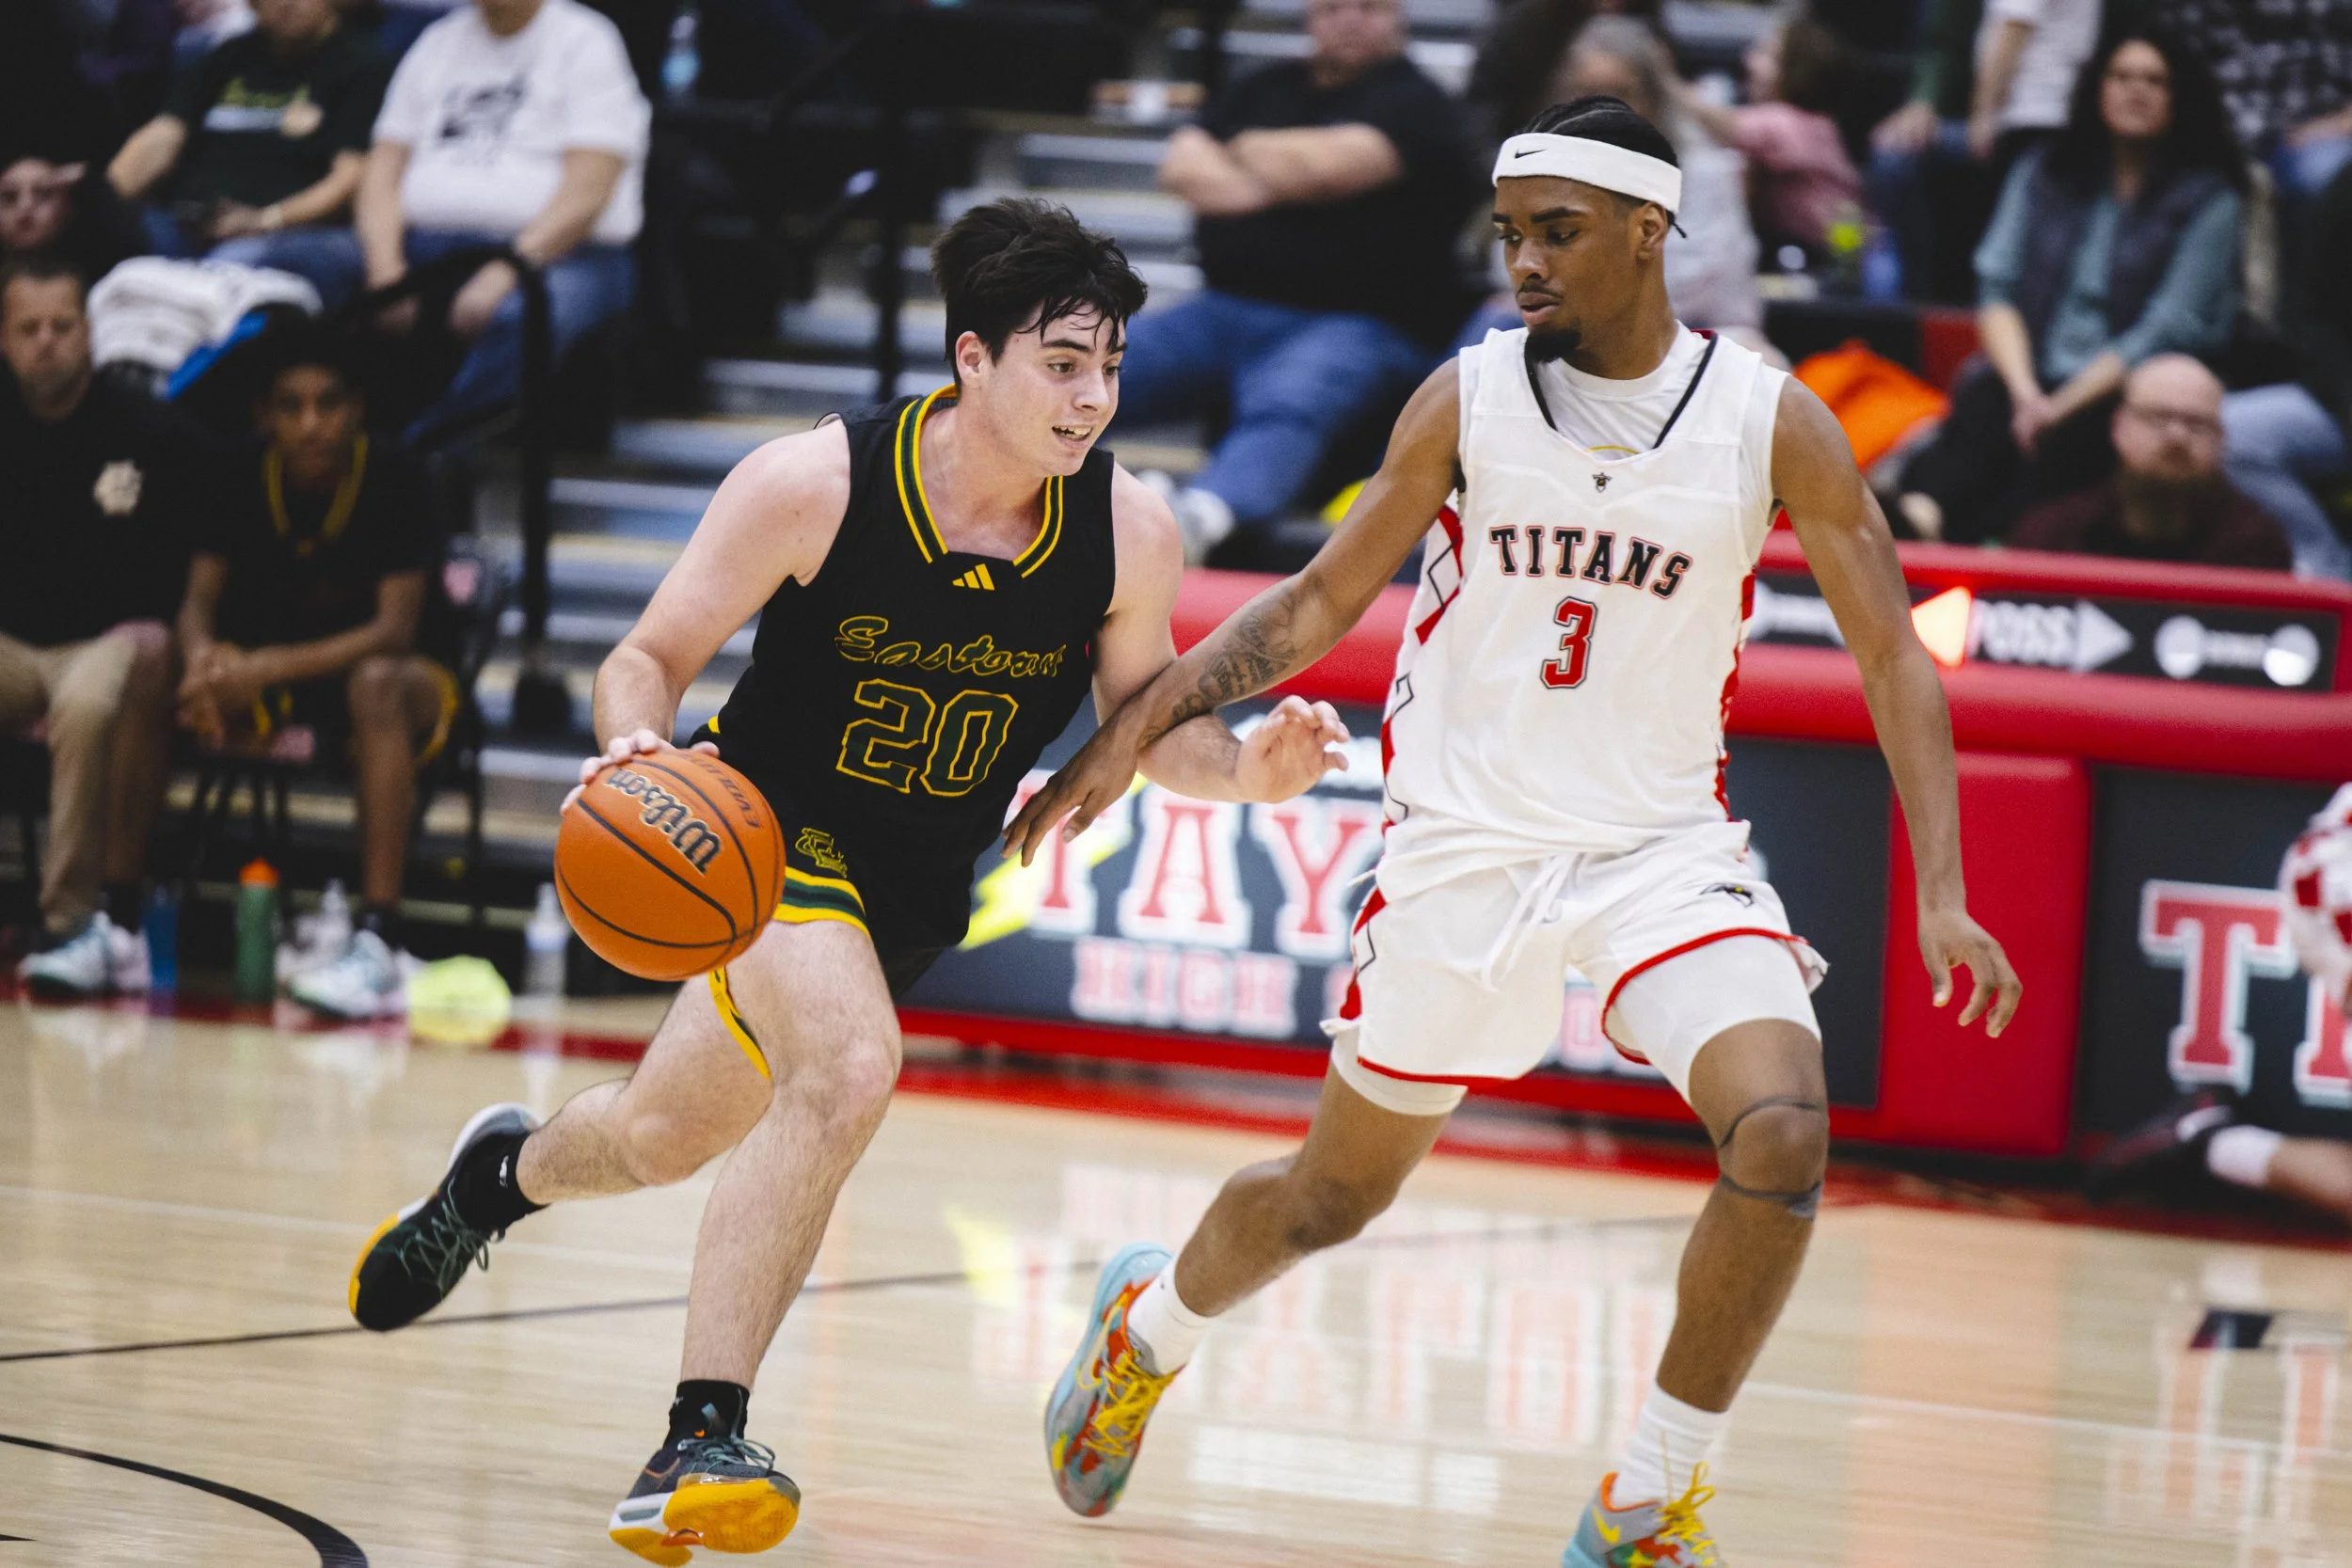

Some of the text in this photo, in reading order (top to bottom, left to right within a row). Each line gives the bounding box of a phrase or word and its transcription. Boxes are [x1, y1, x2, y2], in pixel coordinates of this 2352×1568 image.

[1489, 524, 1693, 599] TITANS
[1540, 595, 1598, 689] 3
[835, 678, 1019, 797] 20
[604, 767, 723, 877] Wilson
[1072, 936, 1296, 1037] HIGH
